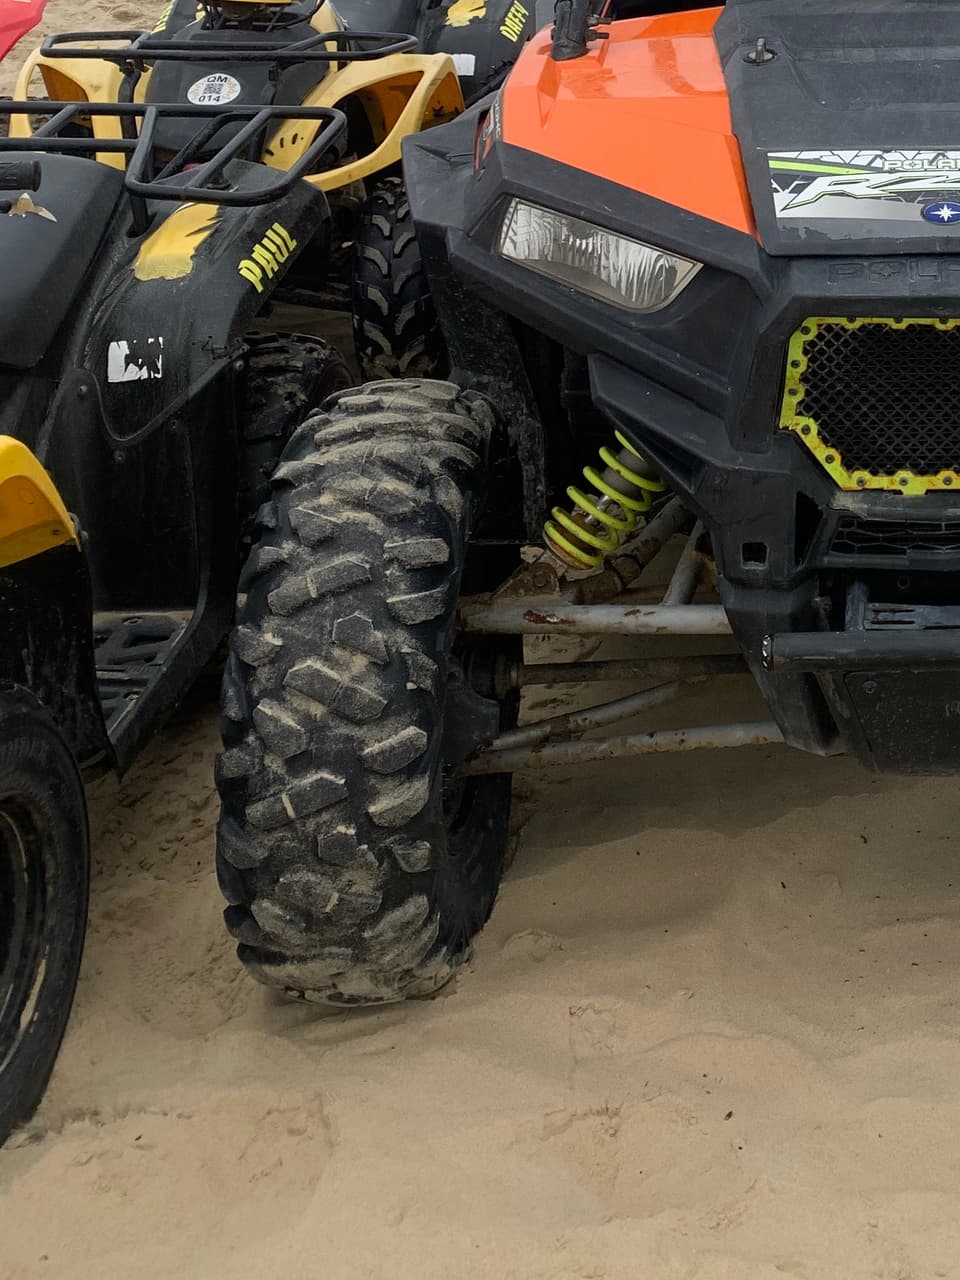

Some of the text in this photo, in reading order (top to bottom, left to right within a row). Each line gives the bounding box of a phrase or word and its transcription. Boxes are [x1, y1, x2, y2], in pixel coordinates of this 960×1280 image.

[499, 0, 529, 42] DAFFY
[207, 75, 228, 83] QM
[198, 94, 221, 103] 014
[237, 221, 298, 294] PAUL
